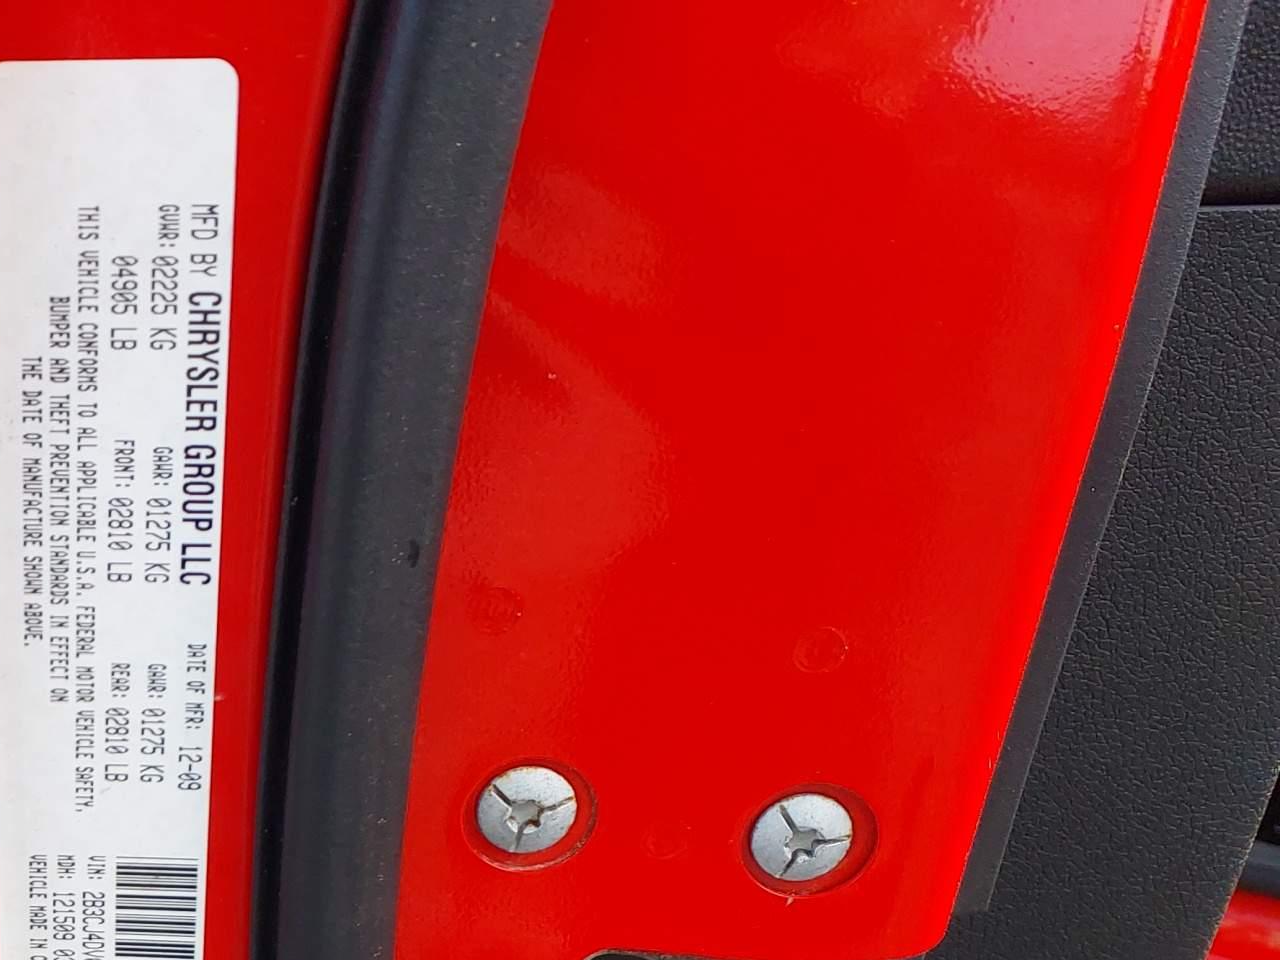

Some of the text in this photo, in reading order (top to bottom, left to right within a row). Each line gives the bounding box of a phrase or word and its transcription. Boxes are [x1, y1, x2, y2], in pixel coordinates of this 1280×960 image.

[78, 206, 99, 241] THIS
[78, 251, 99, 313] VEHICLE
[111, 256, 138, 351] 04905 LB
[150, 205, 179, 351] GVWR: 02225 KG
[78, 323, 98, 392] CONFORMS
[78, 403, 97, 418] TO
[180, 205, 222, 585] MFD BY CHRYSLER GROUP LLC
[77, 428, 96, 452] ALL
[22, 357, 43, 648] THE DATE OF MANUFACTURE SHOWN ABOVE.
[50, 297, 70, 702] BUMPER AND THEFT PREVENTION STANDARDS IN EFFECT ON
[77, 461, 96, 543] APPLICABLE
[107, 440, 134, 583] FRONT: 02810 LB
[145, 447, 173, 584] GAWR: 01275 KG
[77, 552, 96, 597] U.S.A.
[76, 607, 95, 659] FEDERAL
[76, 667, 94, 703] MOTOR
[76, 711, 94, 760] VEHICLE
[105, 664, 130, 783] REAR: 02810 LB
[140, 664, 166, 783] GAWR: 01275 KG
[178, 644, 207, 791] DATE OF MFR: 12-09
[29, 855, 47, 899] VEHICLE
[58, 855, 75, 880] MDH:
[88, 856, 105, 881] VIN:
[30, 906, 47, 931] MADE
[30, 939, 47, 949] IN
[53, 893, 75, 941] 121509
